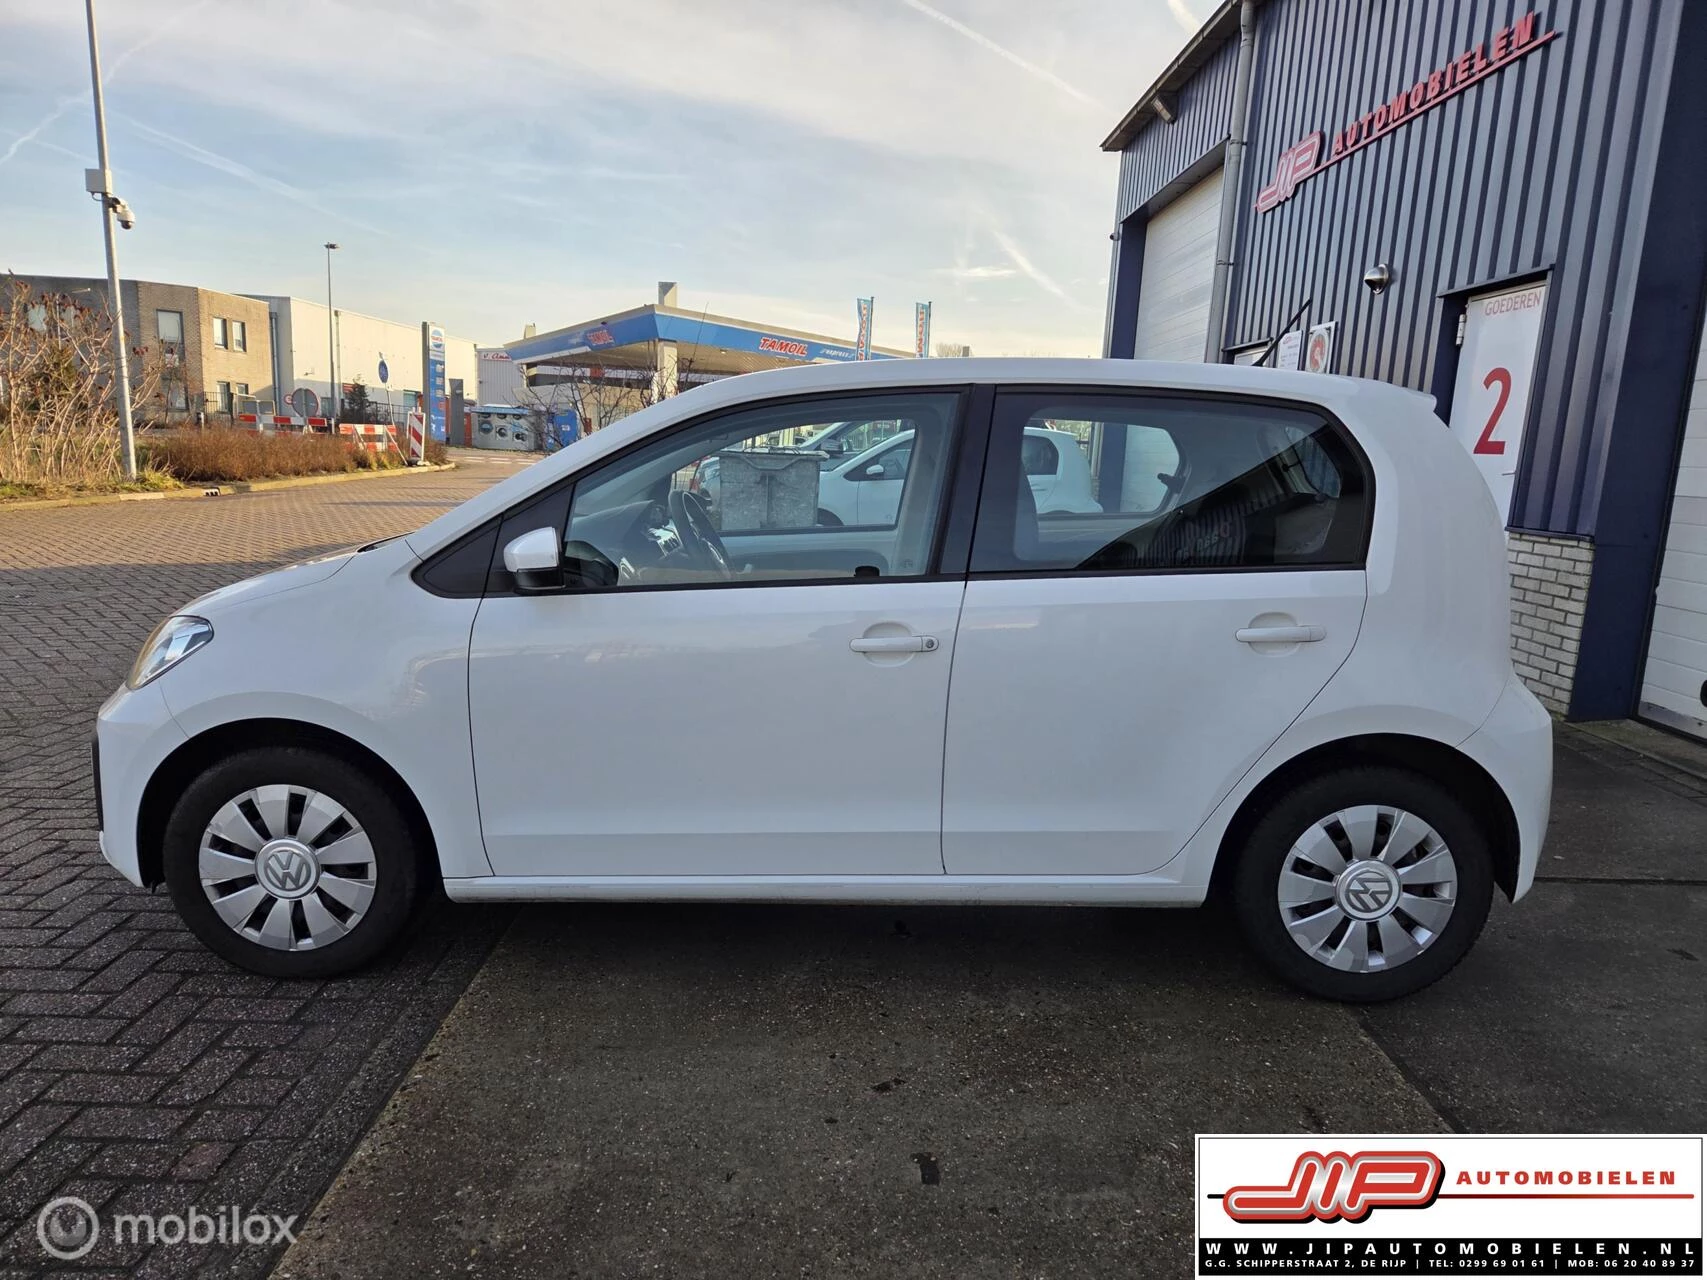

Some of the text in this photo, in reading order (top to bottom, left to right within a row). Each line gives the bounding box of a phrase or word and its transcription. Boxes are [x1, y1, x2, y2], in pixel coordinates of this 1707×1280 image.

[1257, 11, 1536, 213] JIP AUTOMOBIELEN
[1484, 290, 1541, 316] GOEDEREN
[759, 337, 808, 357] TAMOIL
[1473, 367, 1512, 455] 2
